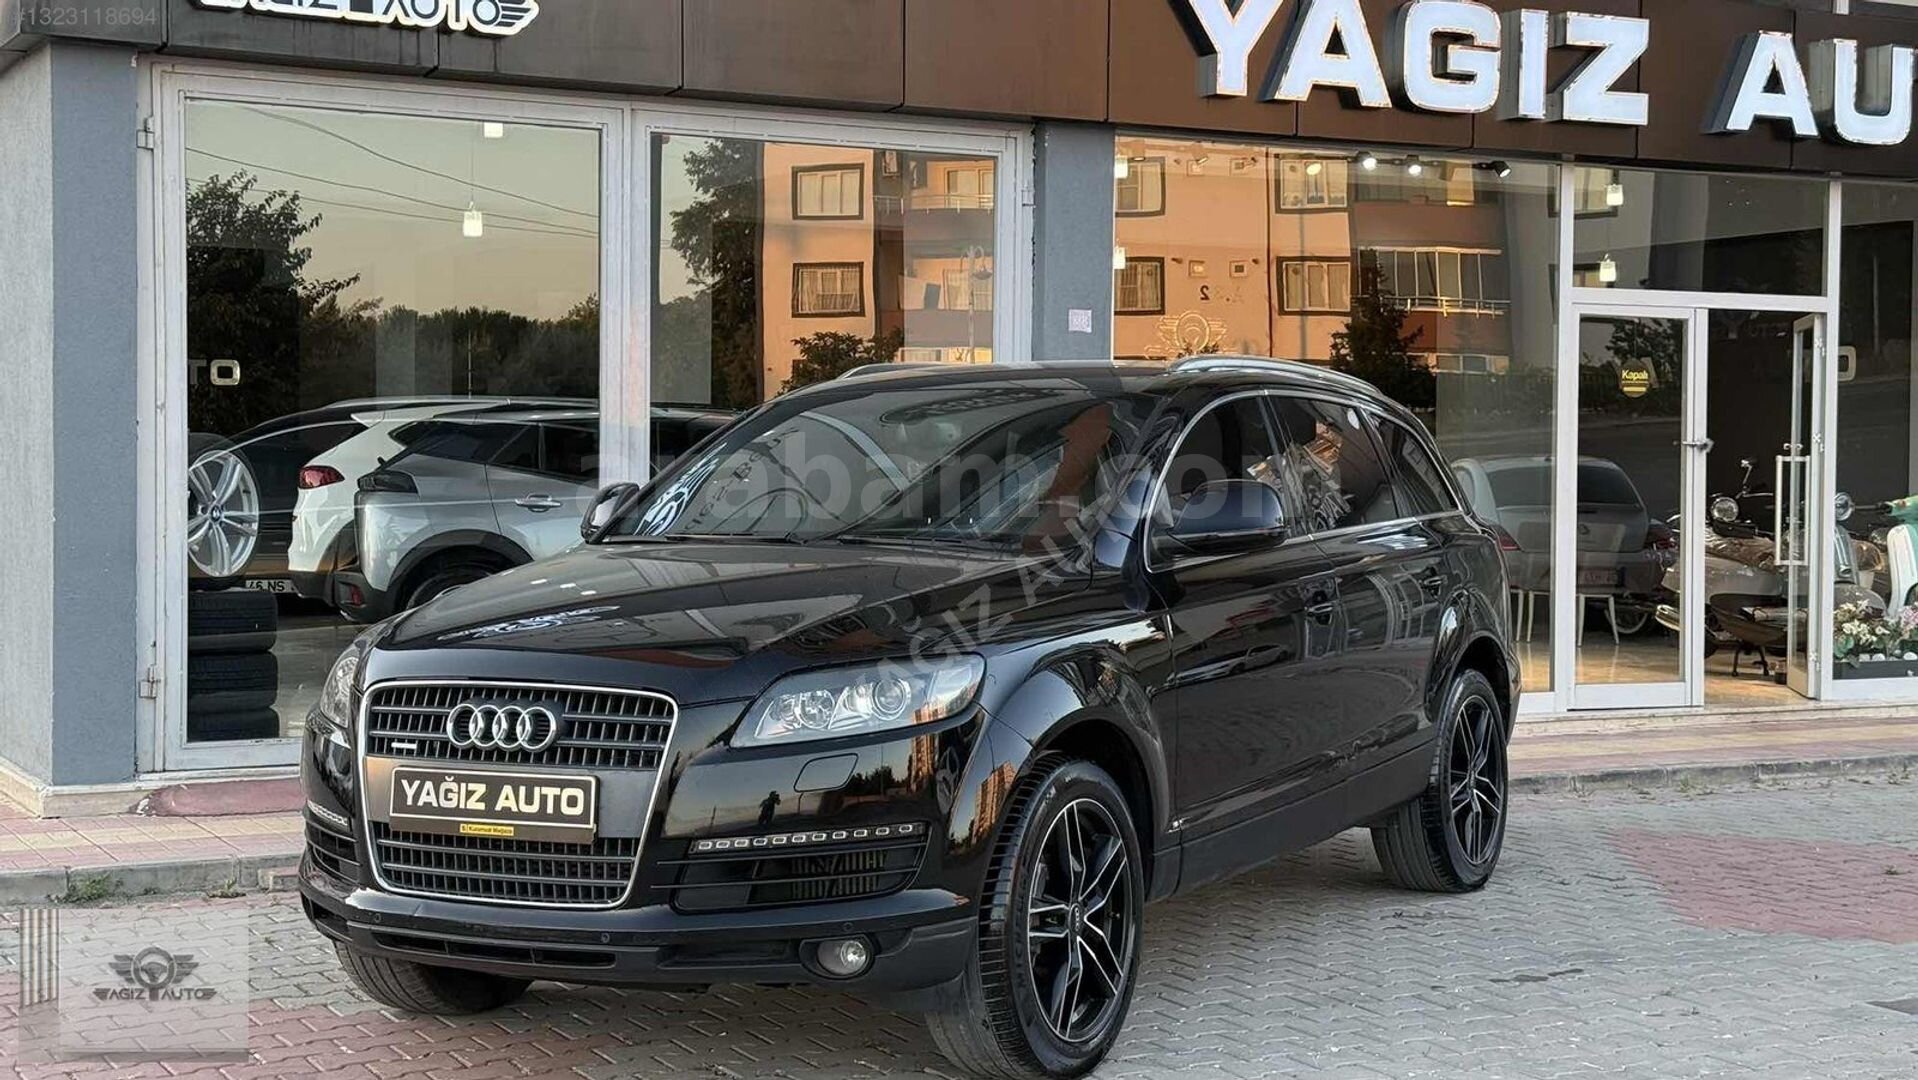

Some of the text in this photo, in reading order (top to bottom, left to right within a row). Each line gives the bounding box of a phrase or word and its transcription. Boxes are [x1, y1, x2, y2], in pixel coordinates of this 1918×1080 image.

[1189, 0, 1917, 145] YAGIZ AU
[401, 776, 585, 817] YAĞIZ AUTO
